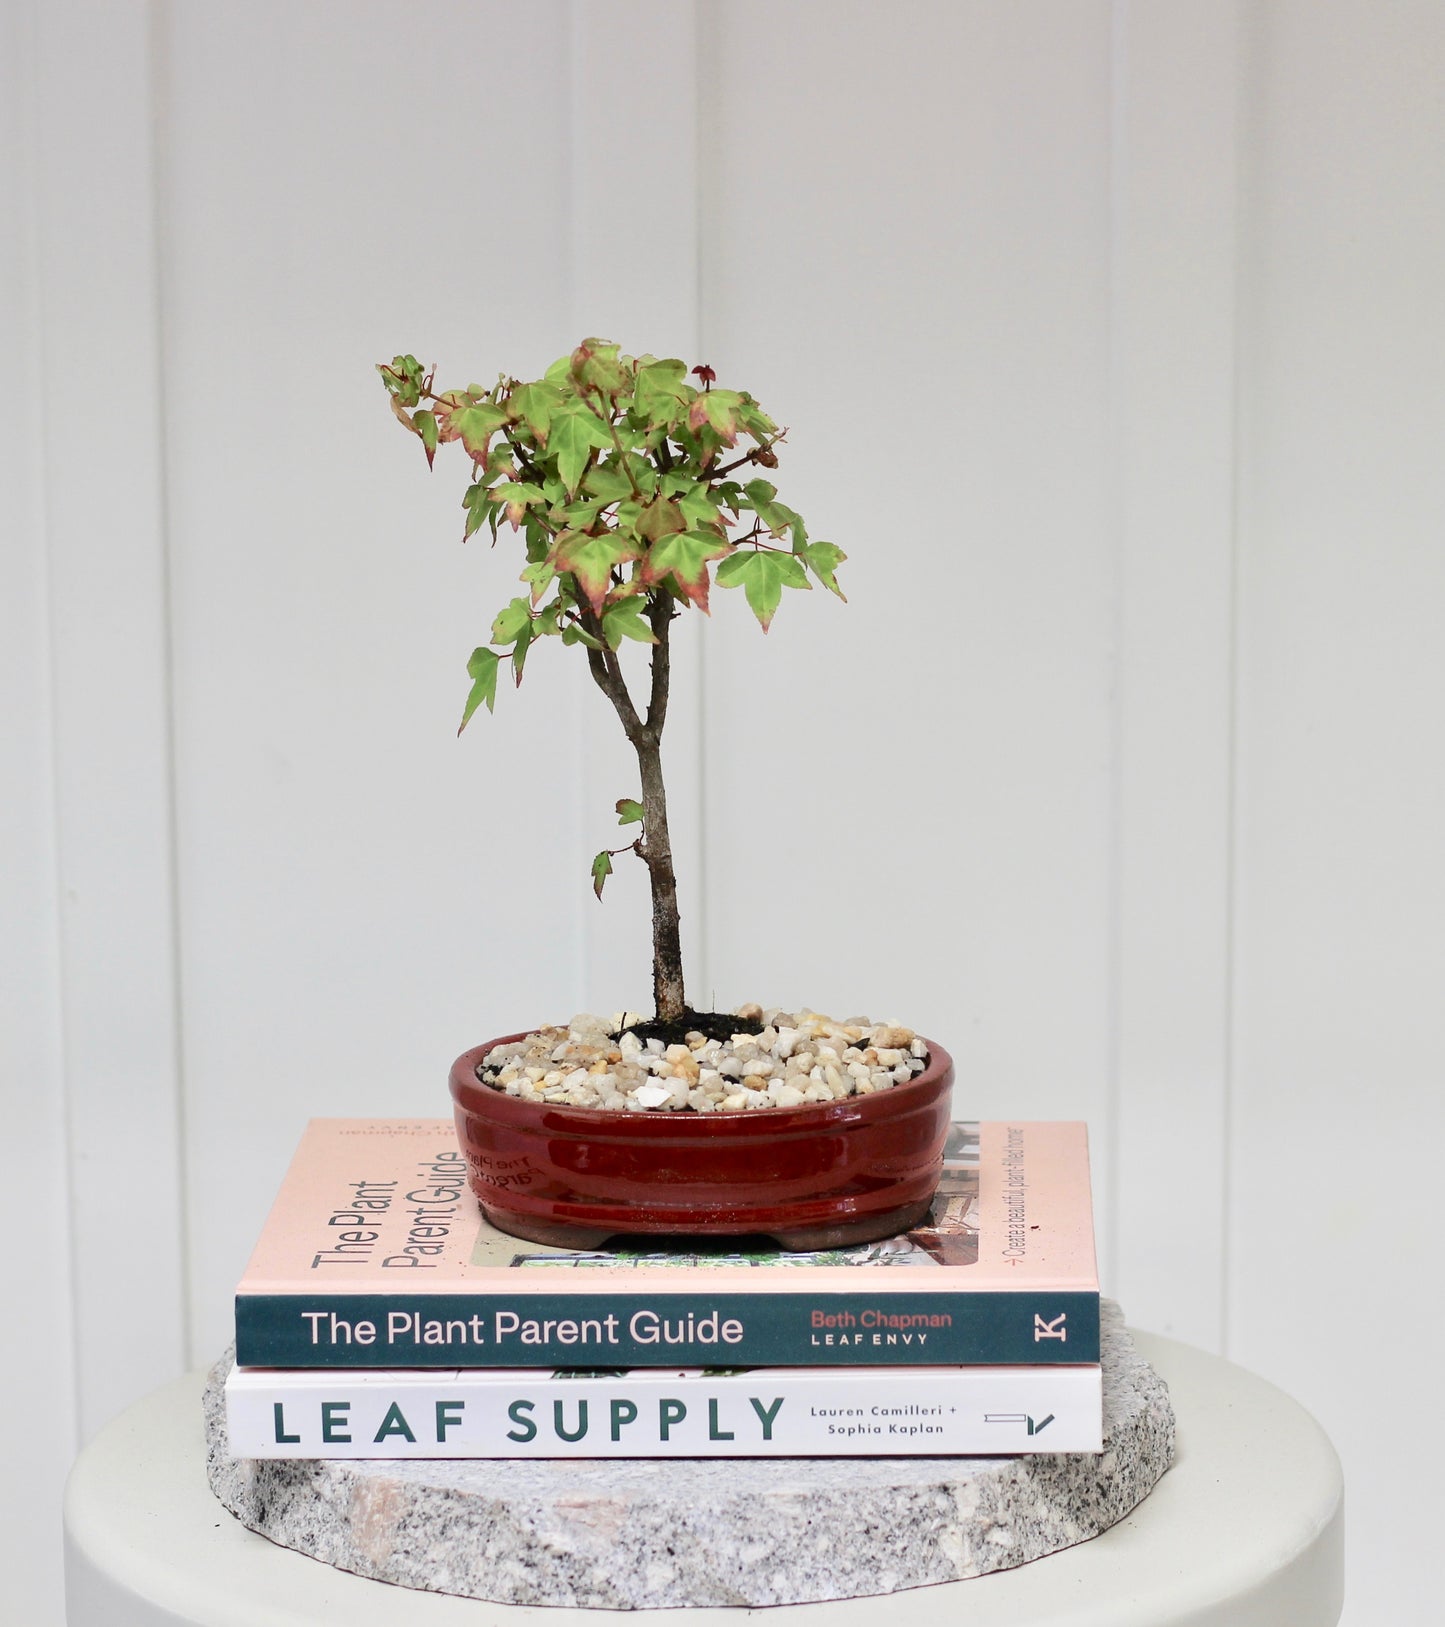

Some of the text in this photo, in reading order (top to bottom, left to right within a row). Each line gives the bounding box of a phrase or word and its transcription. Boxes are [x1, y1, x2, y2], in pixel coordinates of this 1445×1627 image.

[381, 1151, 468, 1268] Parent Guide
[311, 1180, 399, 1269] The Plant
[1002, 1229, 1026, 1257] Create
[301, 1310, 744, 1345] The Plant Parent Guide
[811, 1310, 952, 1330] Beth Chapman
[811, 1333, 929, 1346] LEAF ENVY
[273, 1397, 785, 1445] LEAF SUPPLY
[811, 1406, 865, 1417] Lauren
[871, 1405, 943, 1417] Camilleri
[828, 1423, 944, 1437] Sophia Kaplan
